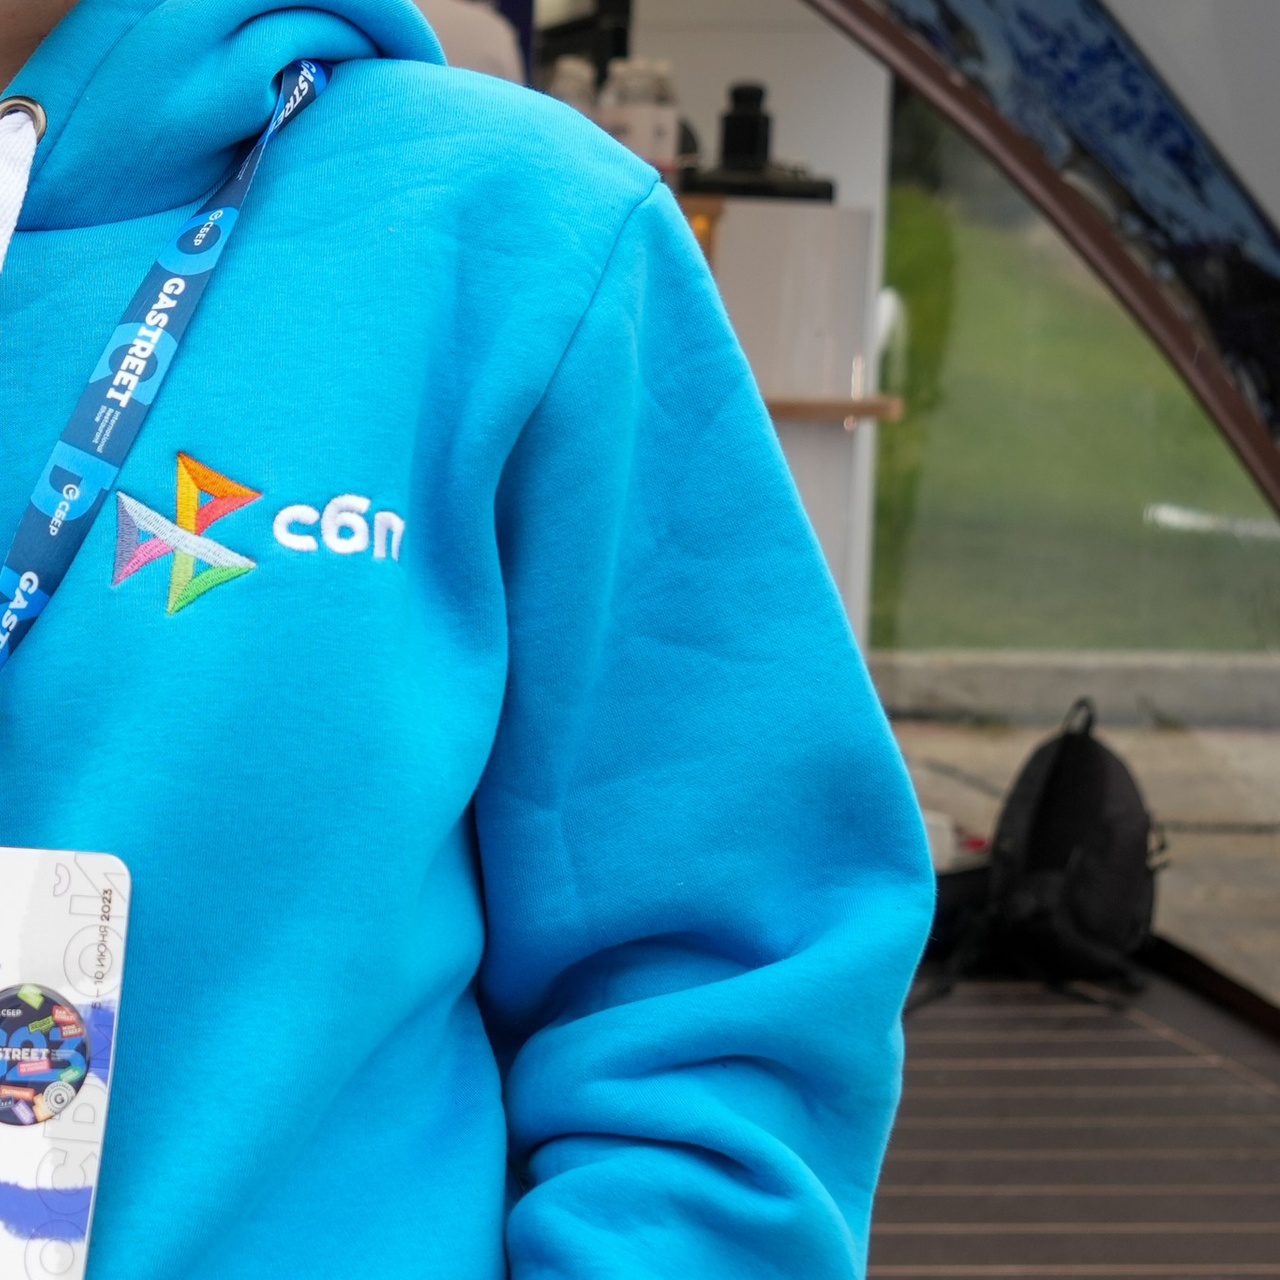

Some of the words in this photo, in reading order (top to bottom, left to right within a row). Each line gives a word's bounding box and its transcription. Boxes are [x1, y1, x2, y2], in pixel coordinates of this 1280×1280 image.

[193, 221, 215, 247] СБЕР
[105, 276, 187, 409] GASTREET
[48, 500, 71, 537] СБЕР
[100, 888, 113, 921] 2023
[95, 924, 109, 967] ИЮНЯ
[94, 971, 105, 985] 10
[1, 1008, 23, 1017] СБЕР
